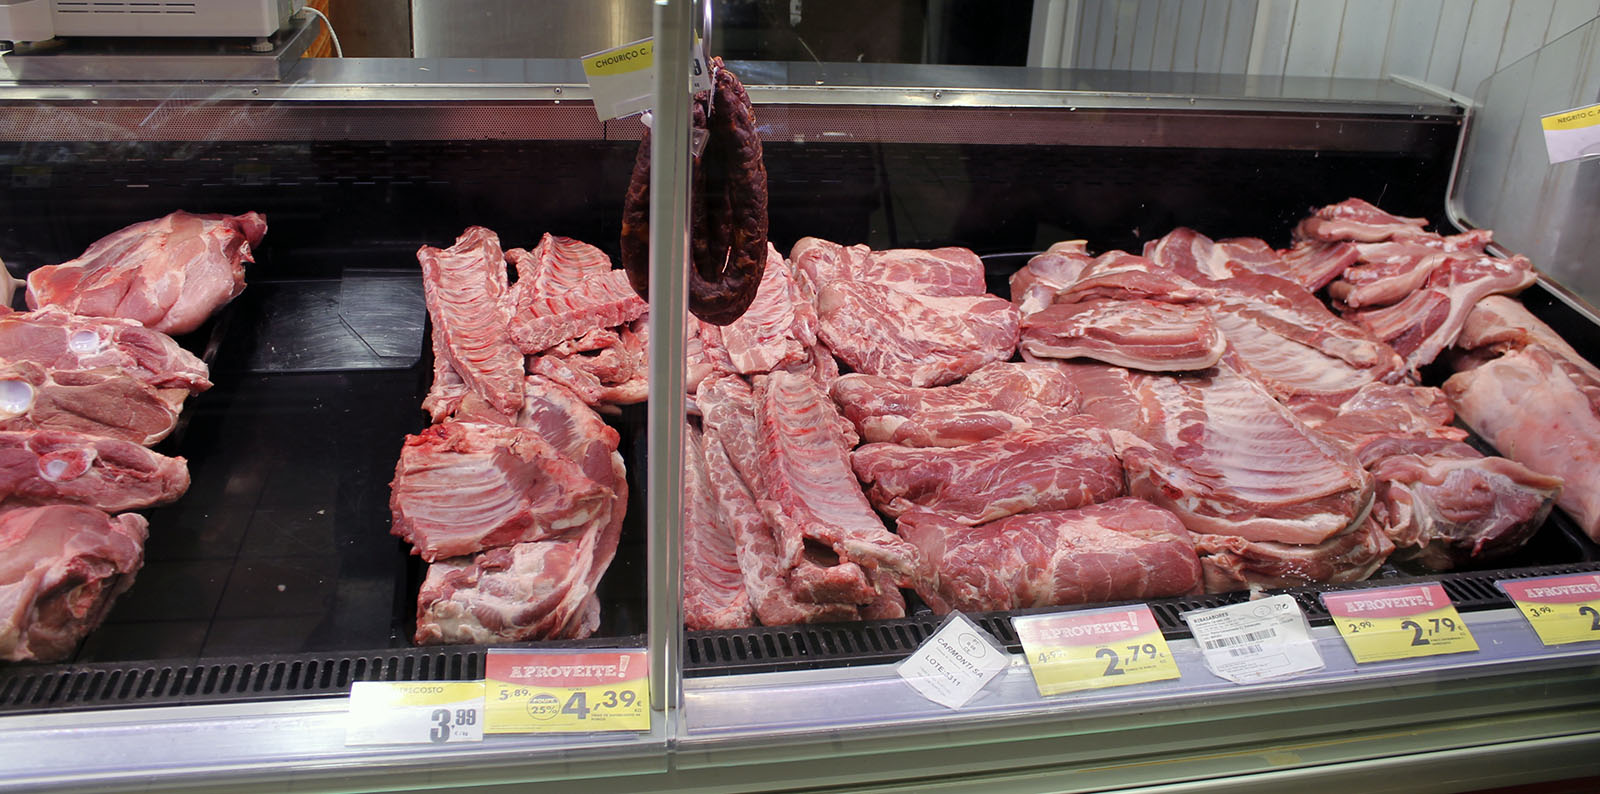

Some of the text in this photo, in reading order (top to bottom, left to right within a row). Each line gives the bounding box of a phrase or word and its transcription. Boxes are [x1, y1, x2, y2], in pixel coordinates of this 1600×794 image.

[595, 50, 639, 68] CHOURIÇO
[1557, 112, 1587, 123] NEGRITO
[1344, 587, 1434, 613] APROVEITE!
[1040, 612, 1139, 640] APROVEITE!
[937, 638, 974, 670] CARMONTI
[509, 655, 630, 681] APROVEITE!
[531, 706, 557, 714] 25%
